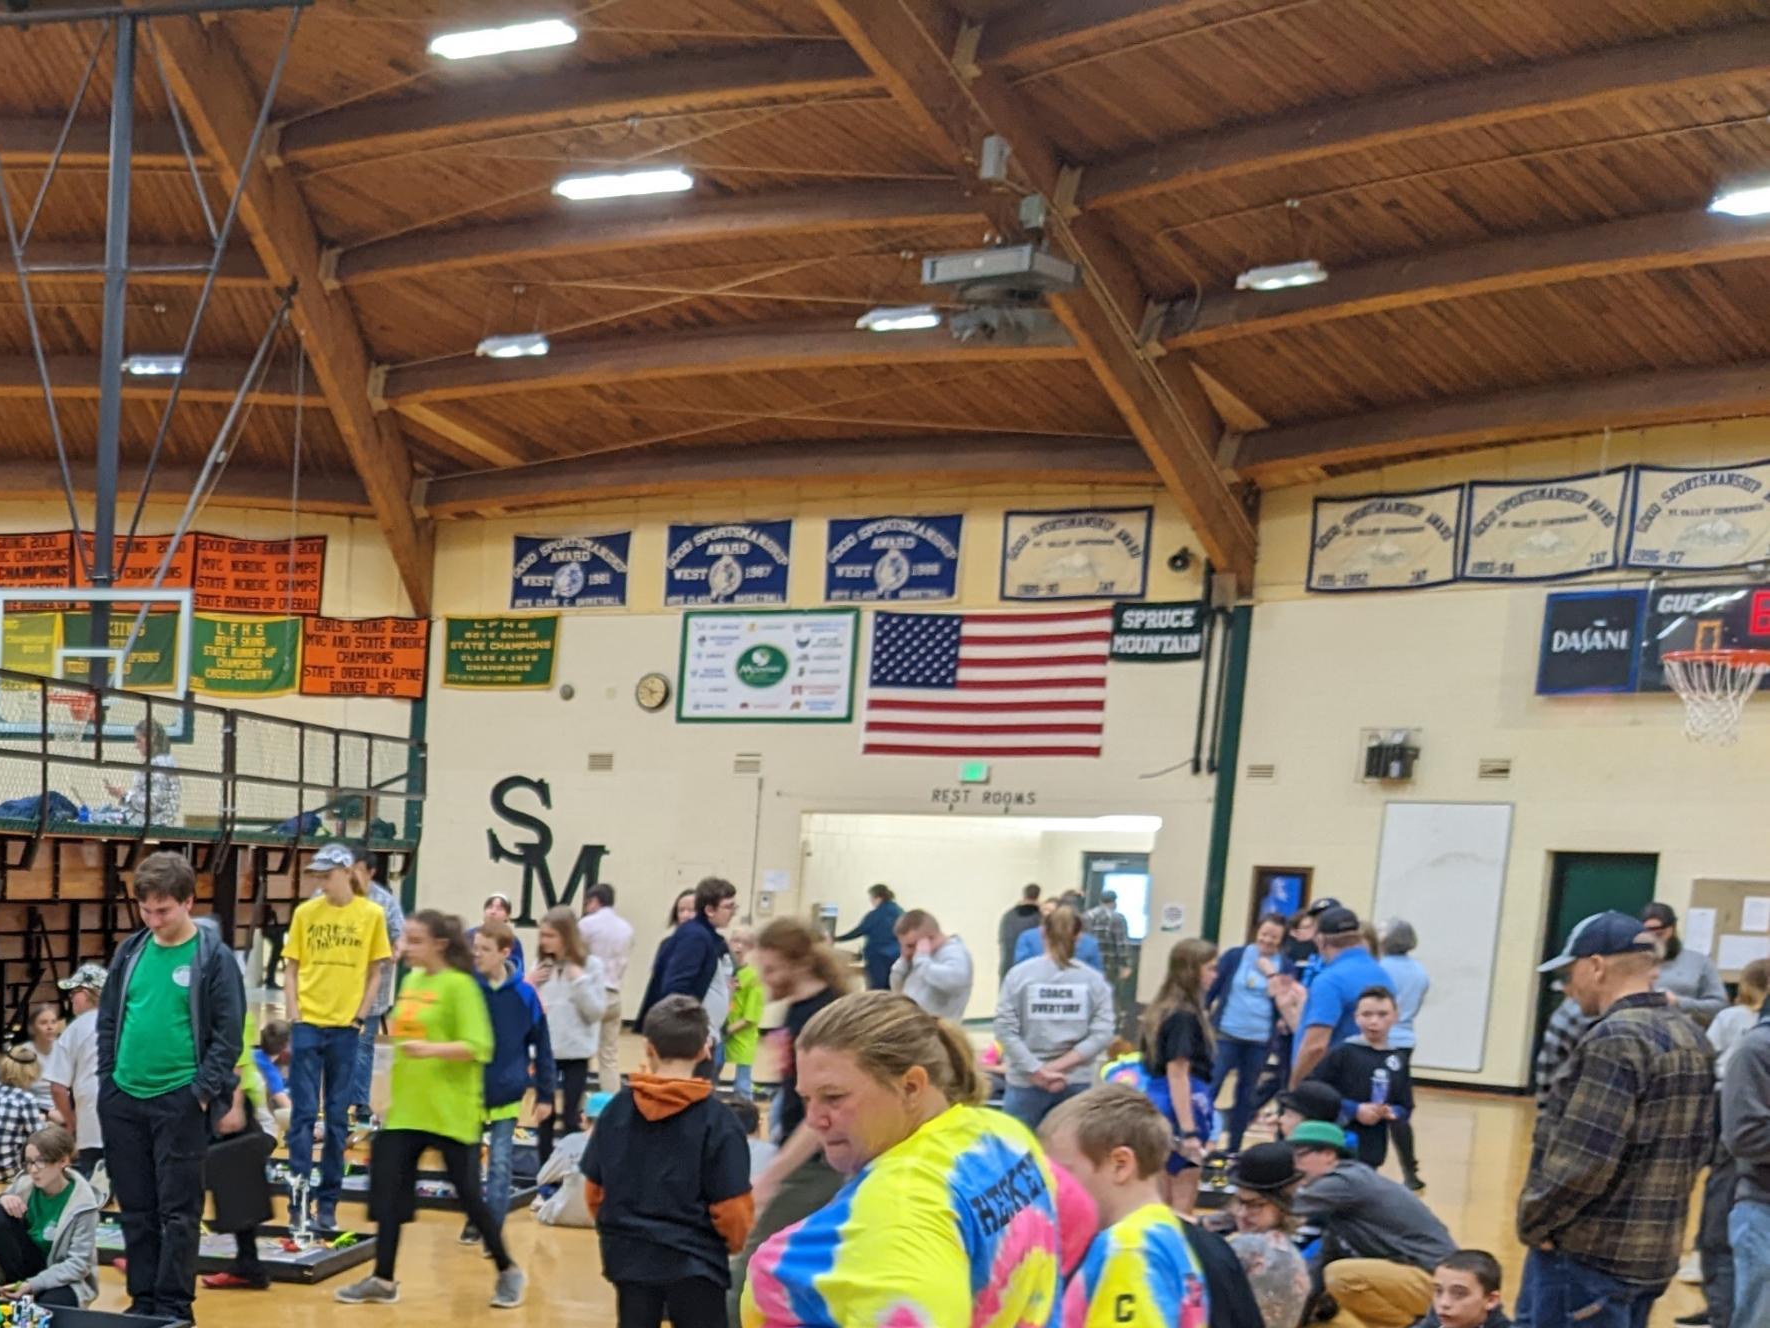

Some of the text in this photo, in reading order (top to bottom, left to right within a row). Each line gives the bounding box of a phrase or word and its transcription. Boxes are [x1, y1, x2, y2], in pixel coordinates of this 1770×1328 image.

[1634, 472, 1763, 533] GOOD SPORTSMANSHIP
[1472, 487, 1616, 538] GOOD SPORTSMANSHIP AWARD
[667, 525, 789, 570] GOOD SPORTSMANSHIP
[827, 519, 958, 564] GOOD SPORTSMANSHIP
[870, 536, 917, 550] AWARD
[549, 549, 591, 563] AWARD
[706, 542, 750, 556] AWARD
[673, 568, 708, 581] WEST
[835, 565, 873, 578] WEST
[196, 577, 228, 589] STATE
[522, 575, 554, 588] WEST
[1121, 607, 1197, 630] SPRUCE
[314, 620, 343, 633] GIRLS
[354, 636, 385, 649] STATE
[450, 640, 552, 651] STATE CHAMPIONS
[1112, 632, 1202, 655] MOUNTAIN
[336, 651, 394, 665] CHAMPIONS
[304, 667, 335, 679] STATE
[340, 667, 380, 681] OVERALL
[466, 663, 531, 672] CHAMPIONS
[931, 787, 1037, 806] REST ROOMS
[1038, 987, 1074, 999] COACH
[1116, 1293, 1136, 1323] C
